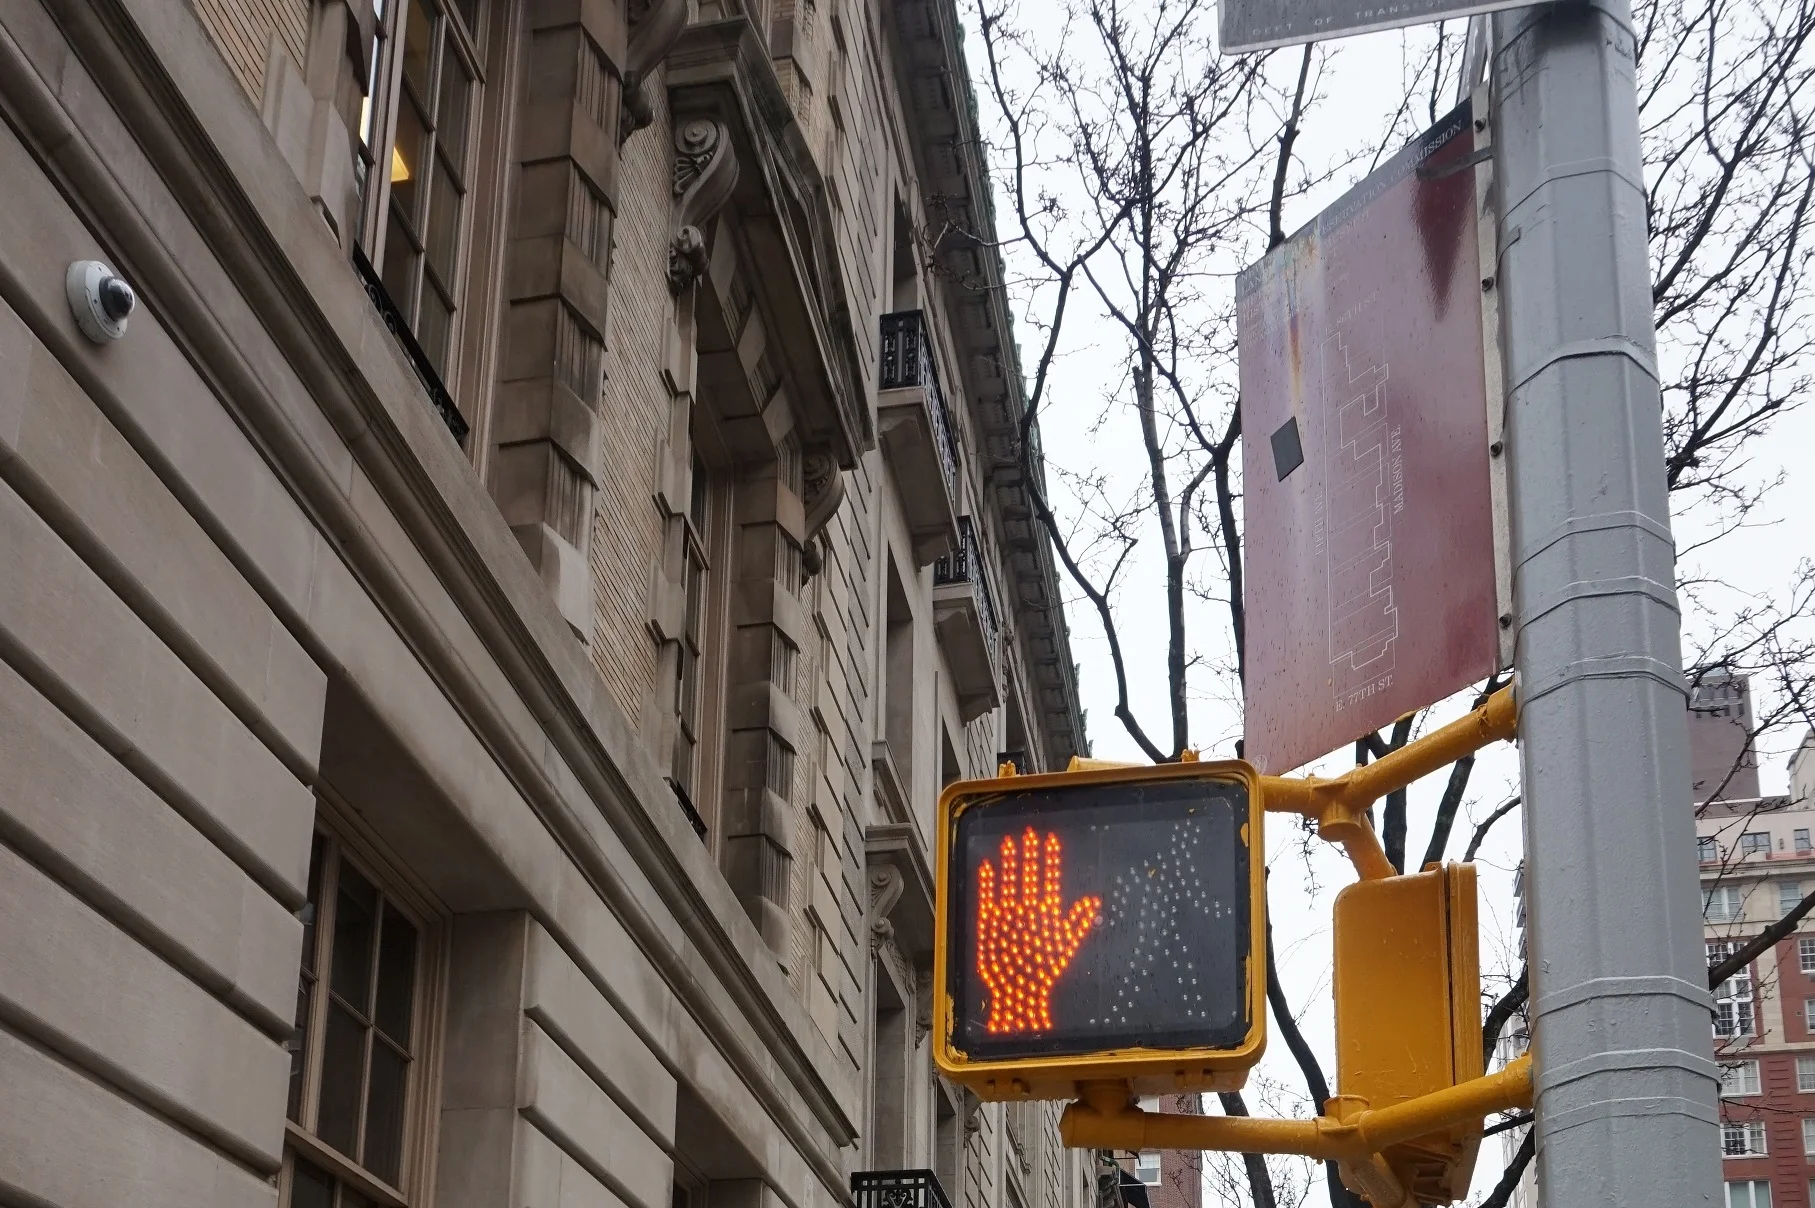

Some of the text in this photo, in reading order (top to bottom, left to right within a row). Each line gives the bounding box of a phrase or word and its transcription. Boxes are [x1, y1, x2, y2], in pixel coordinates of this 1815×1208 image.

[1314, 16, 1333, 26] OF
[1393, 454, 1404, 514] MADISON
[1348, 682, 1376, 706] 77TH
